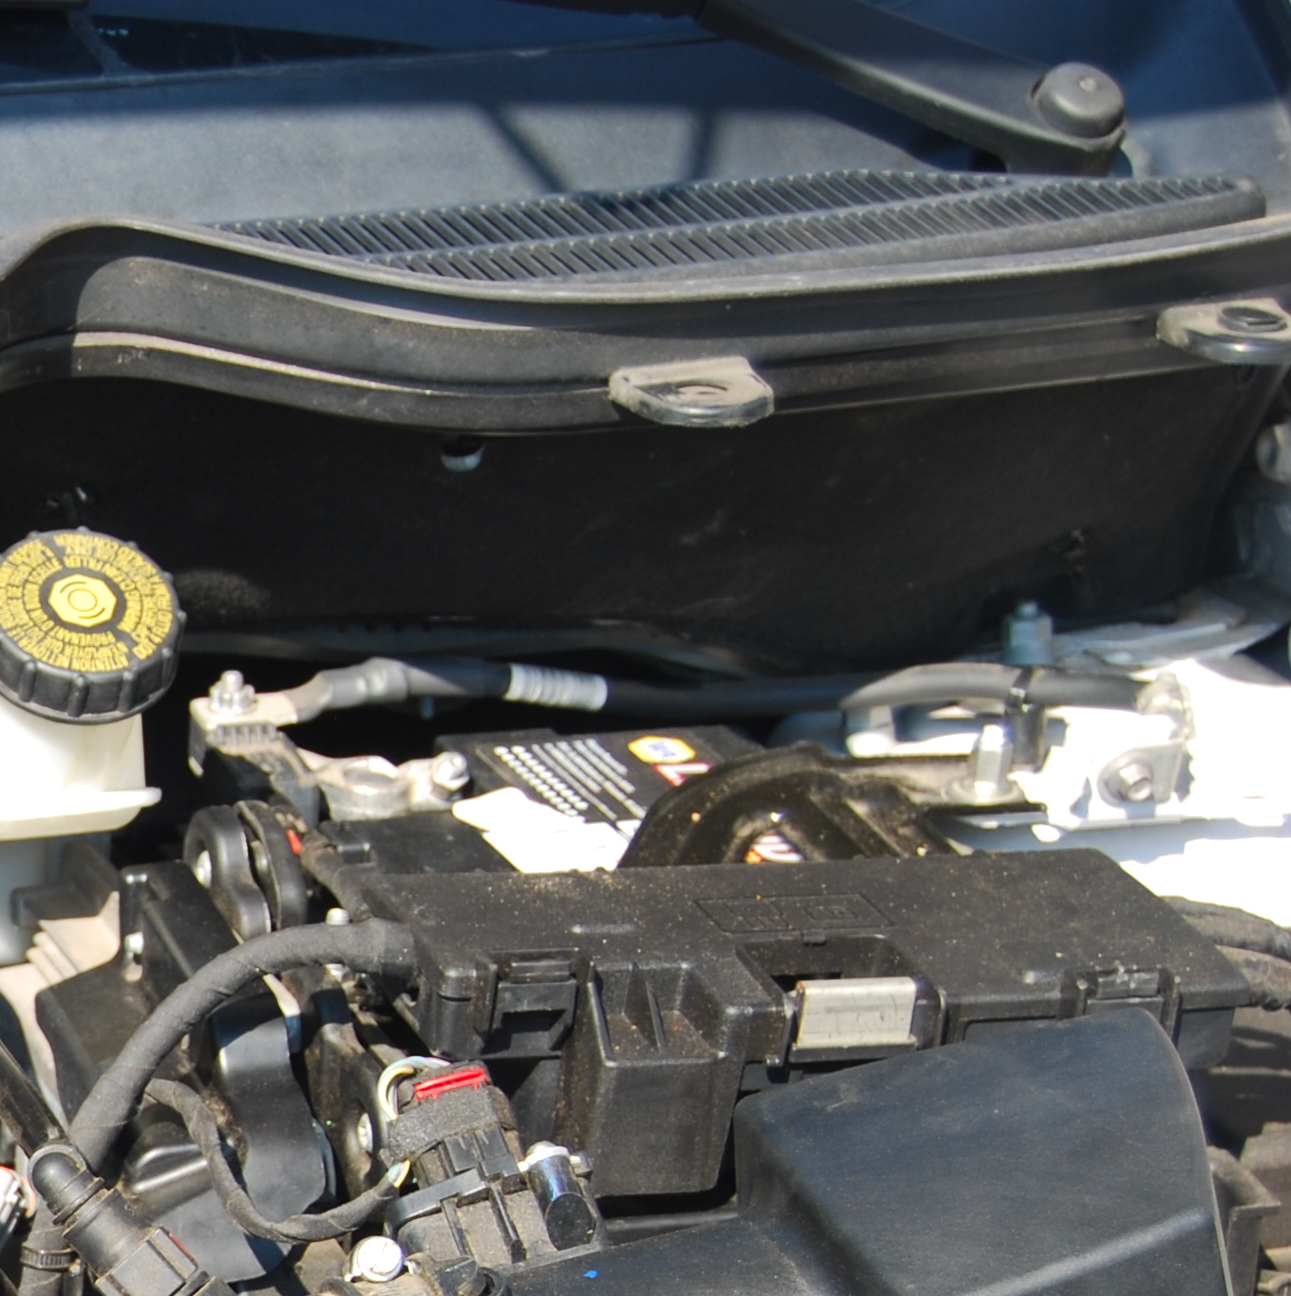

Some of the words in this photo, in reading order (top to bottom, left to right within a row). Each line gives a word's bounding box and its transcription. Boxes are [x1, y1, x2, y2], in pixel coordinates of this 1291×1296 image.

[62, 554, 105, 571] FILLER
[100, 561, 137, 592] CLEAN
[39, 635, 63, 654] QUE
[48, 625, 118, 646] PROVENANT
[17, 635, 70, 669] NETTOYER
[71, 653, 130, 672] ATTENTION
